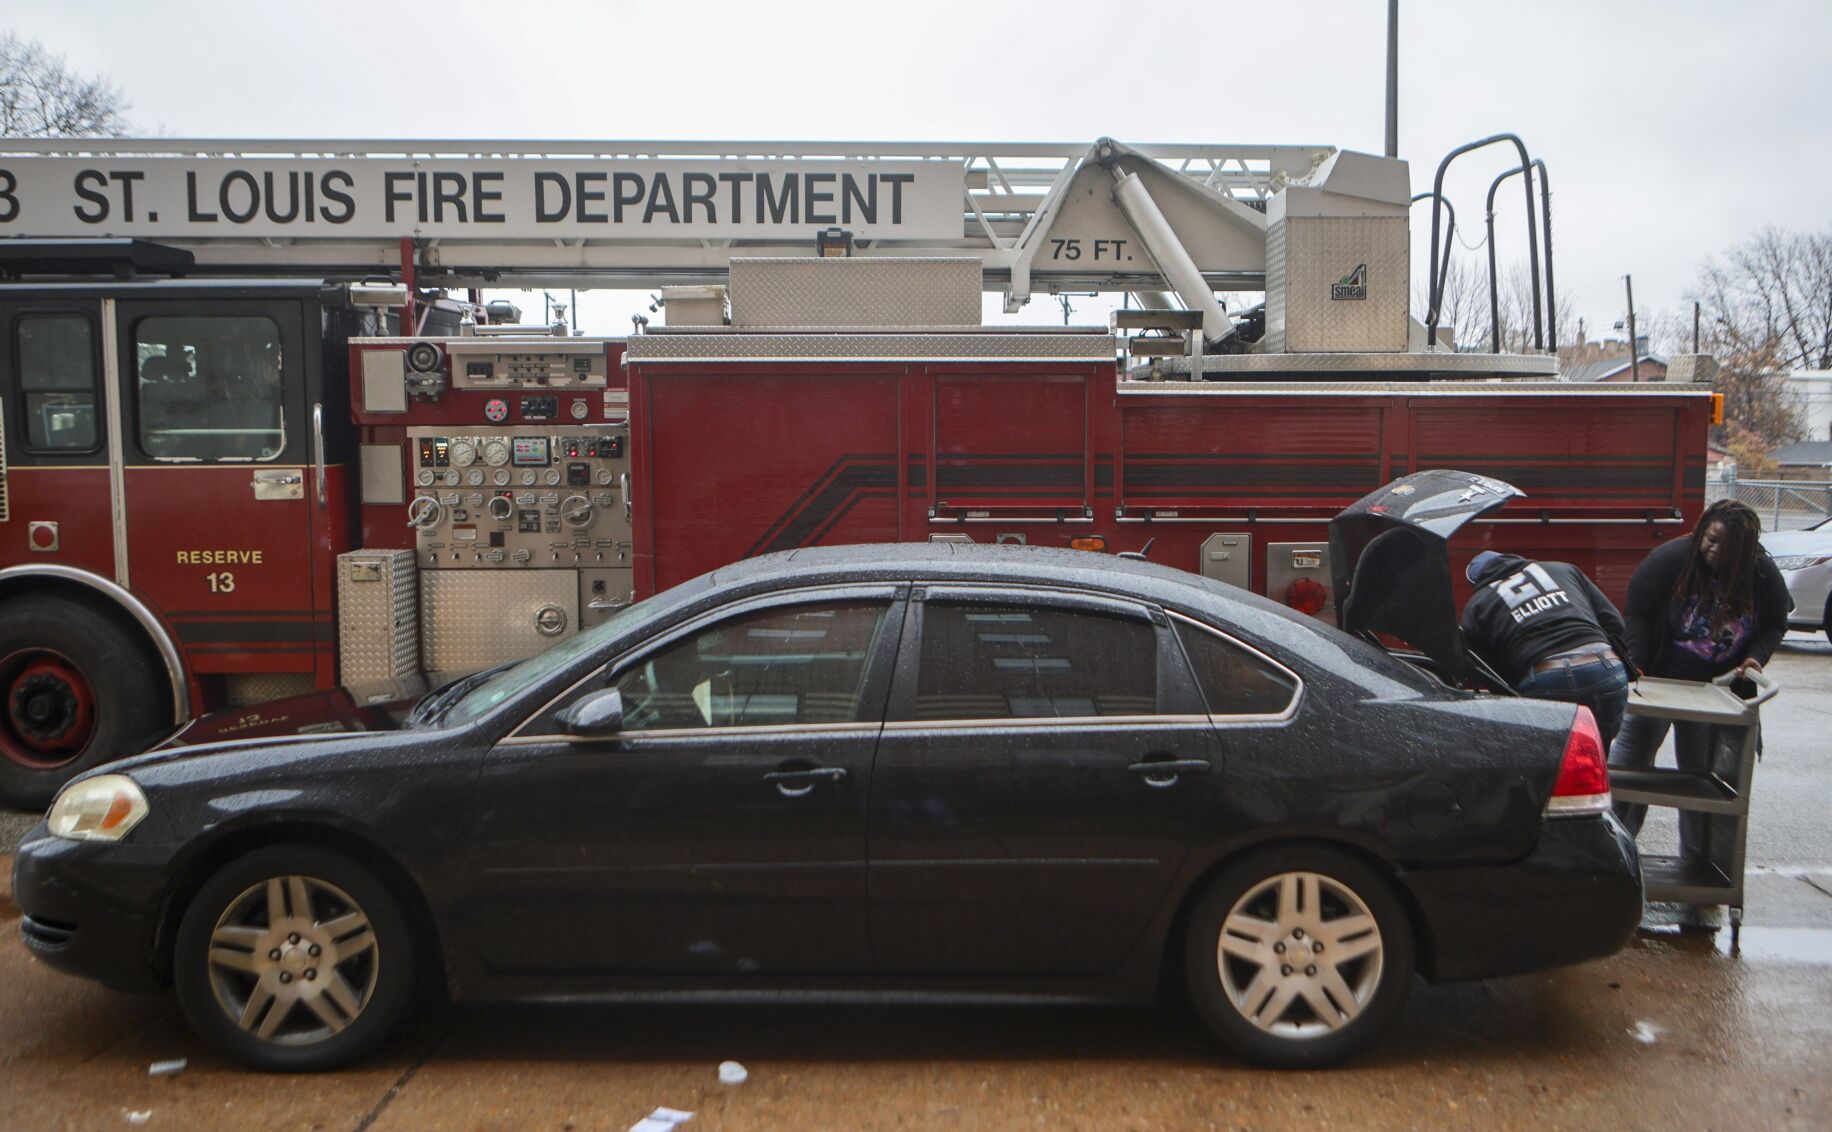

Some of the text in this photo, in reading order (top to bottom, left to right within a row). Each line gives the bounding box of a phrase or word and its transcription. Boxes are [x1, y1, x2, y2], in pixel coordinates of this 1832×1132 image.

[74, 169, 158, 224] ST.
[186, 170, 356, 224] LOUIS
[384, 171, 506, 223] FIRE
[534, 172, 915, 225] DEPARTMENT
[1050, 238, 1134, 261] 75 FT.
[177, 550, 263, 564] RESERVE
[206, 572, 235, 593] 13
[1489, 562, 1561, 610] 21
[1510, 590, 1570, 624] ELLIOTT
